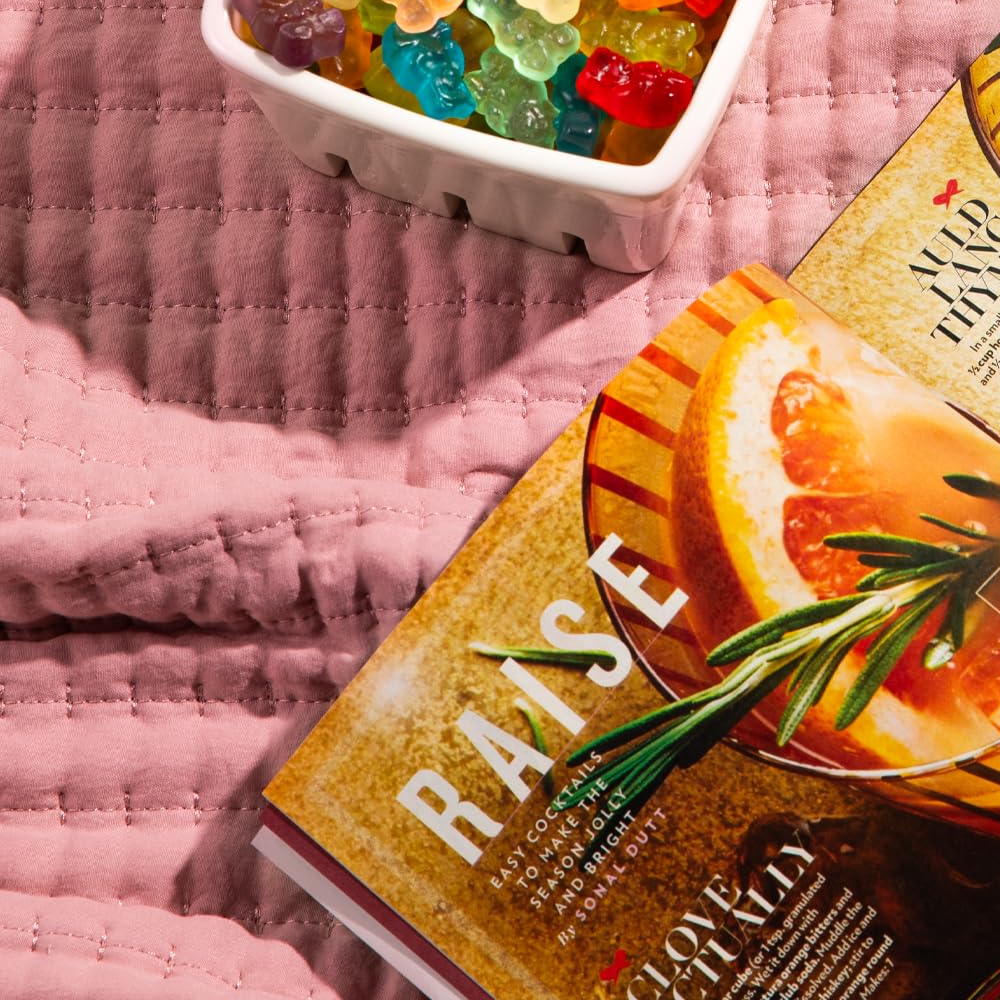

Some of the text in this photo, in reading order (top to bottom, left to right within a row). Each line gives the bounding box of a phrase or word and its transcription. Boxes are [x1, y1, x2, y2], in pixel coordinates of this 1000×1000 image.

[908, 199, 989, 292] AULD
[969, 341, 982, 351] In
[977, 350, 996, 368] cup
[396, 532, 689, 866] RAISE
[490, 750, 602, 888] EASY COCKTAILS
[516, 777, 608, 889] TO MAKE THE
[529, 787, 628, 908] SEASON JOLLY
[552, 810, 637, 914] AND BRIGHT
[574, 861, 625, 921] SONAL
[625, 807, 667, 856] DUTT
[626, 873, 742, 1000] CLOVE
[751, 906, 818, 988] Wet it down with
[780, 887, 852, 981] orange bitters and
